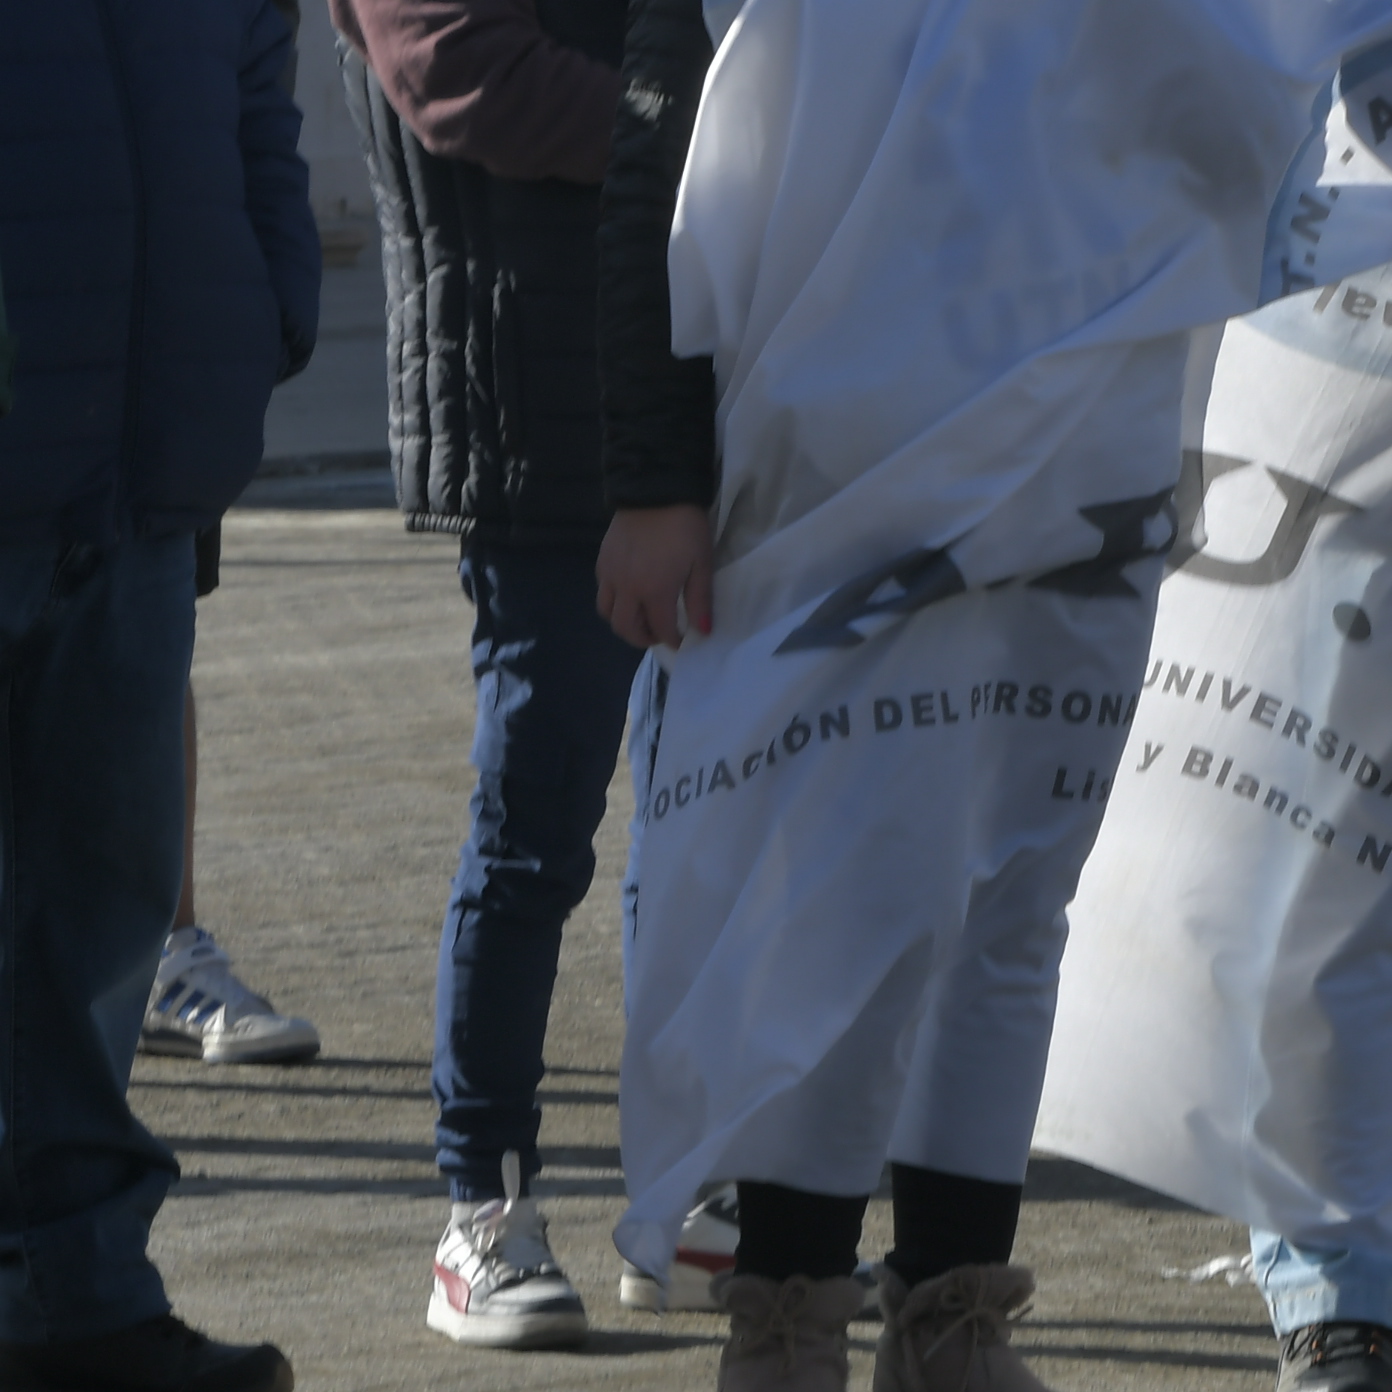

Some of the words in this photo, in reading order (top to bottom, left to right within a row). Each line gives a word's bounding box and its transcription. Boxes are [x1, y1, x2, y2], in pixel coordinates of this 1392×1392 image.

[653, 704, 851, 822] OCIACIÓN
[872, 690, 960, 734] DEL
[1135, 740, 1165, 774] y
[1180, 742, 1337, 850] Blanca
